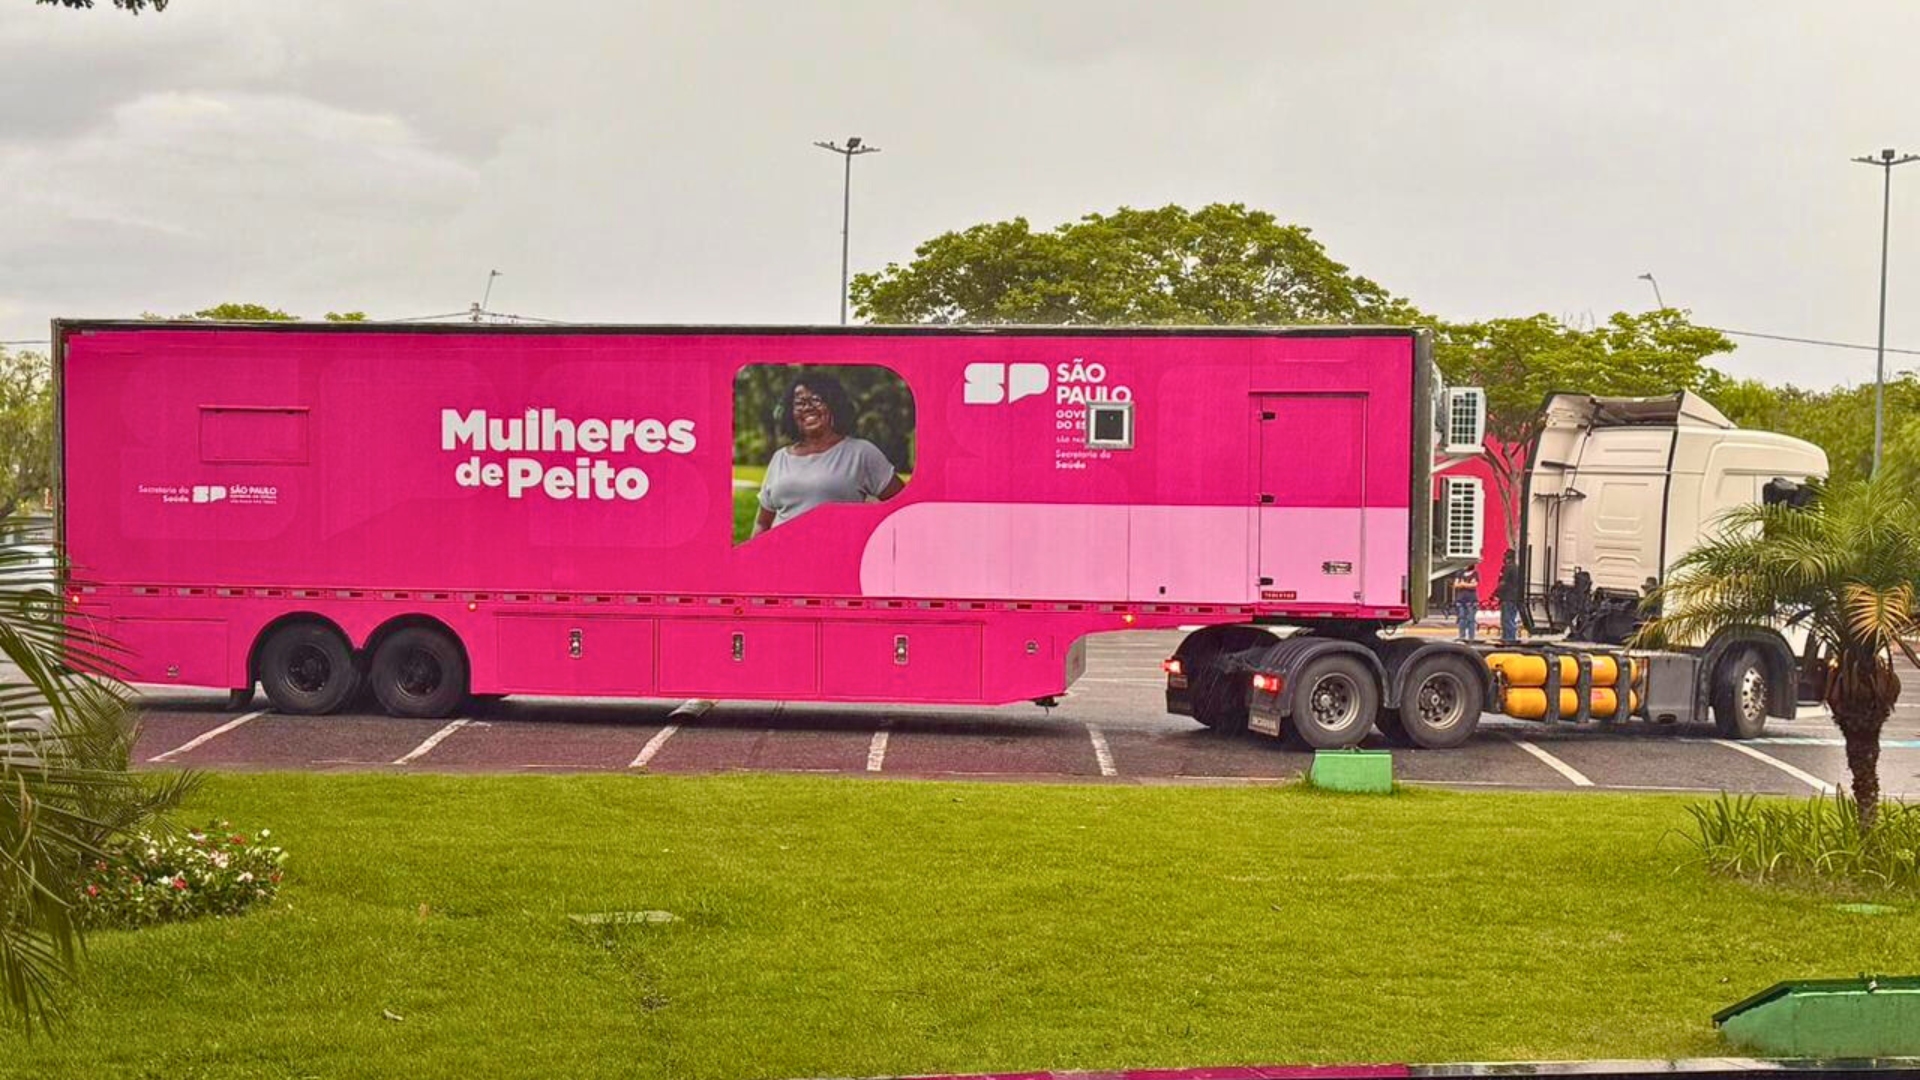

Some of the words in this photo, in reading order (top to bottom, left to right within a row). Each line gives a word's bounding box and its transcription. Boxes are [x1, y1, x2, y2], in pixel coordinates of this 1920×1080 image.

[1056, 358, 1106, 383] SÃO
[1056, 385, 1132, 405] PAULO
[441, 406, 697, 453] Mulheres
[1056, 421, 1072, 430] DO
[455, 456, 504, 487] de
[508, 457, 650, 500] Peito
[230, 484, 248, 494] SÃO
[248, 486, 277, 495] PAULO
